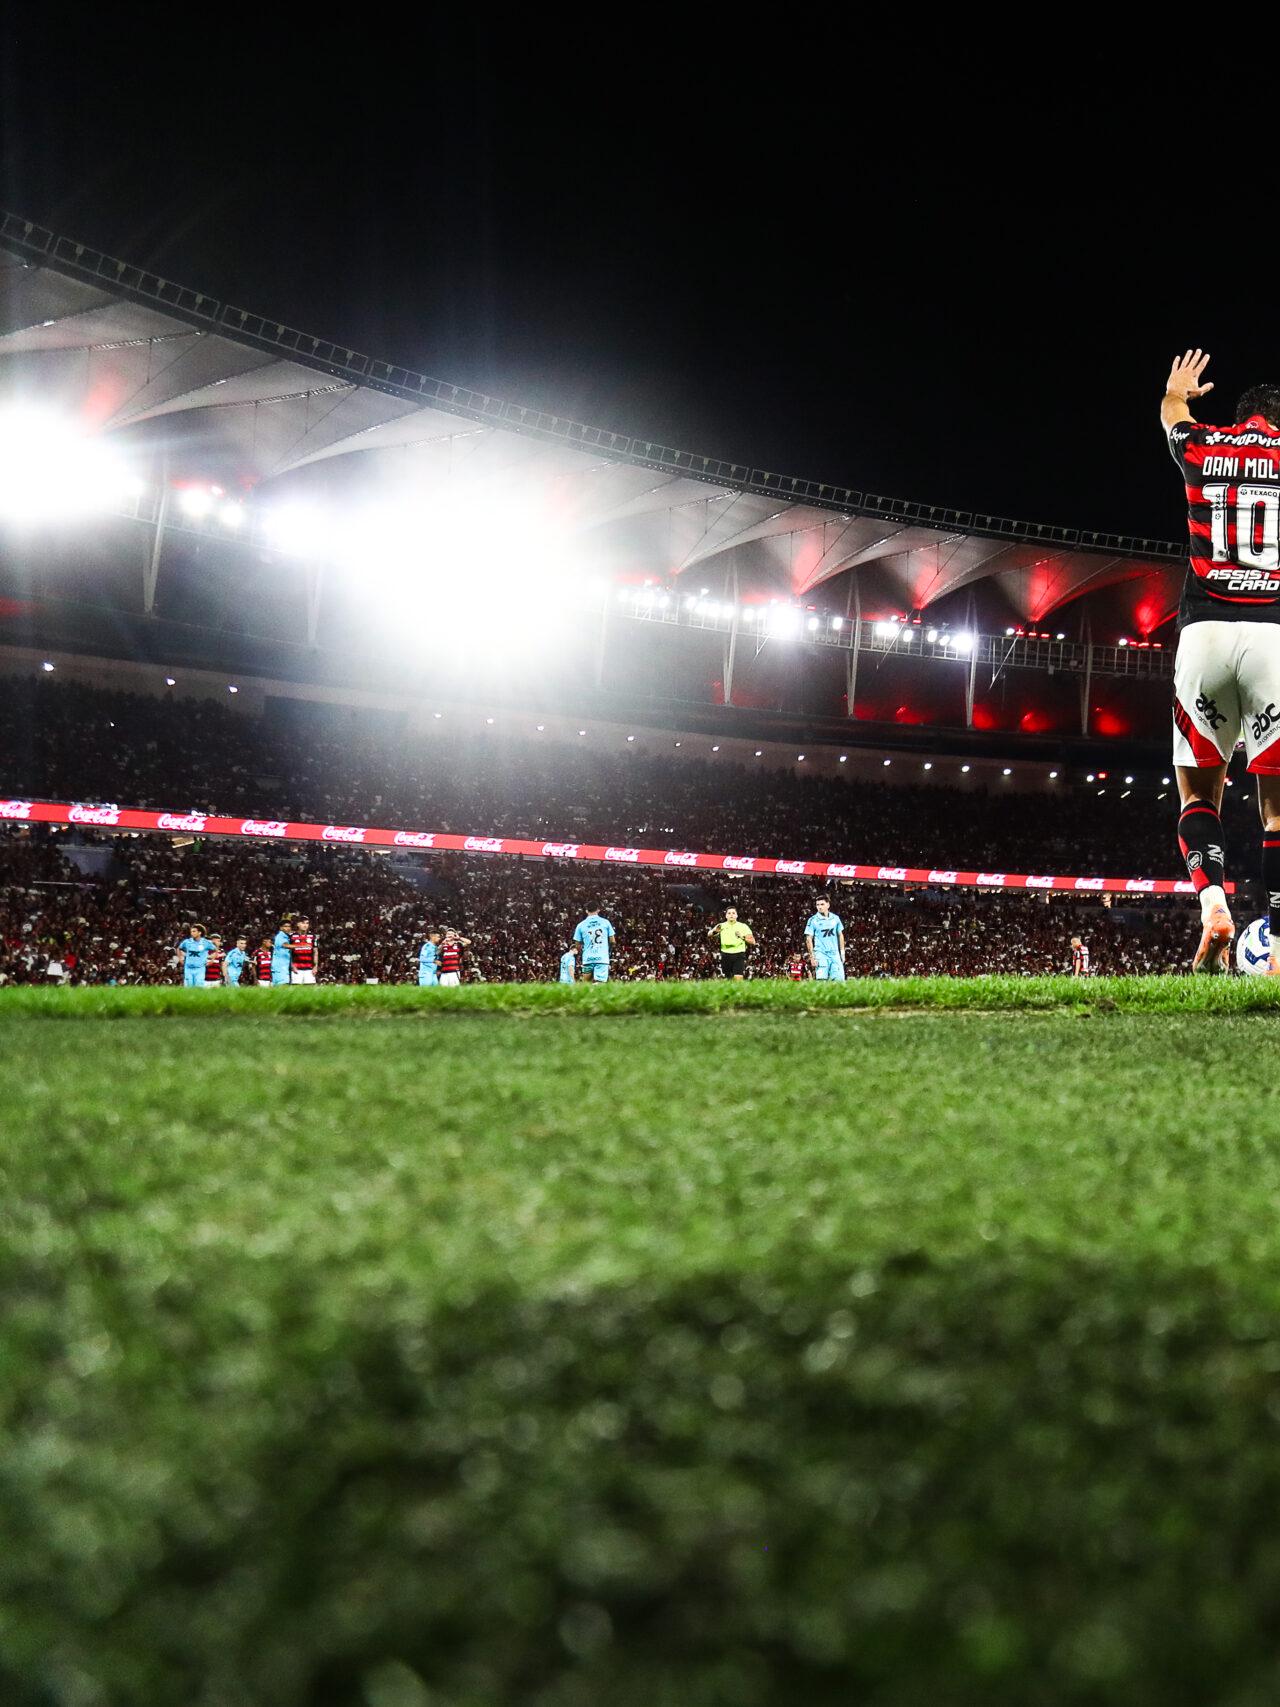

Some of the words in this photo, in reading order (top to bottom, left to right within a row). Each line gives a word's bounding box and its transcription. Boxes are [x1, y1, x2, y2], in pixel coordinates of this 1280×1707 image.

[1202, 456, 1239, 477] DANI
[1250, 489, 1278, 498] TEXACO
[1206, 569, 1270, 580] ASSIST
[1227, 580, 1280, 590] CARD
